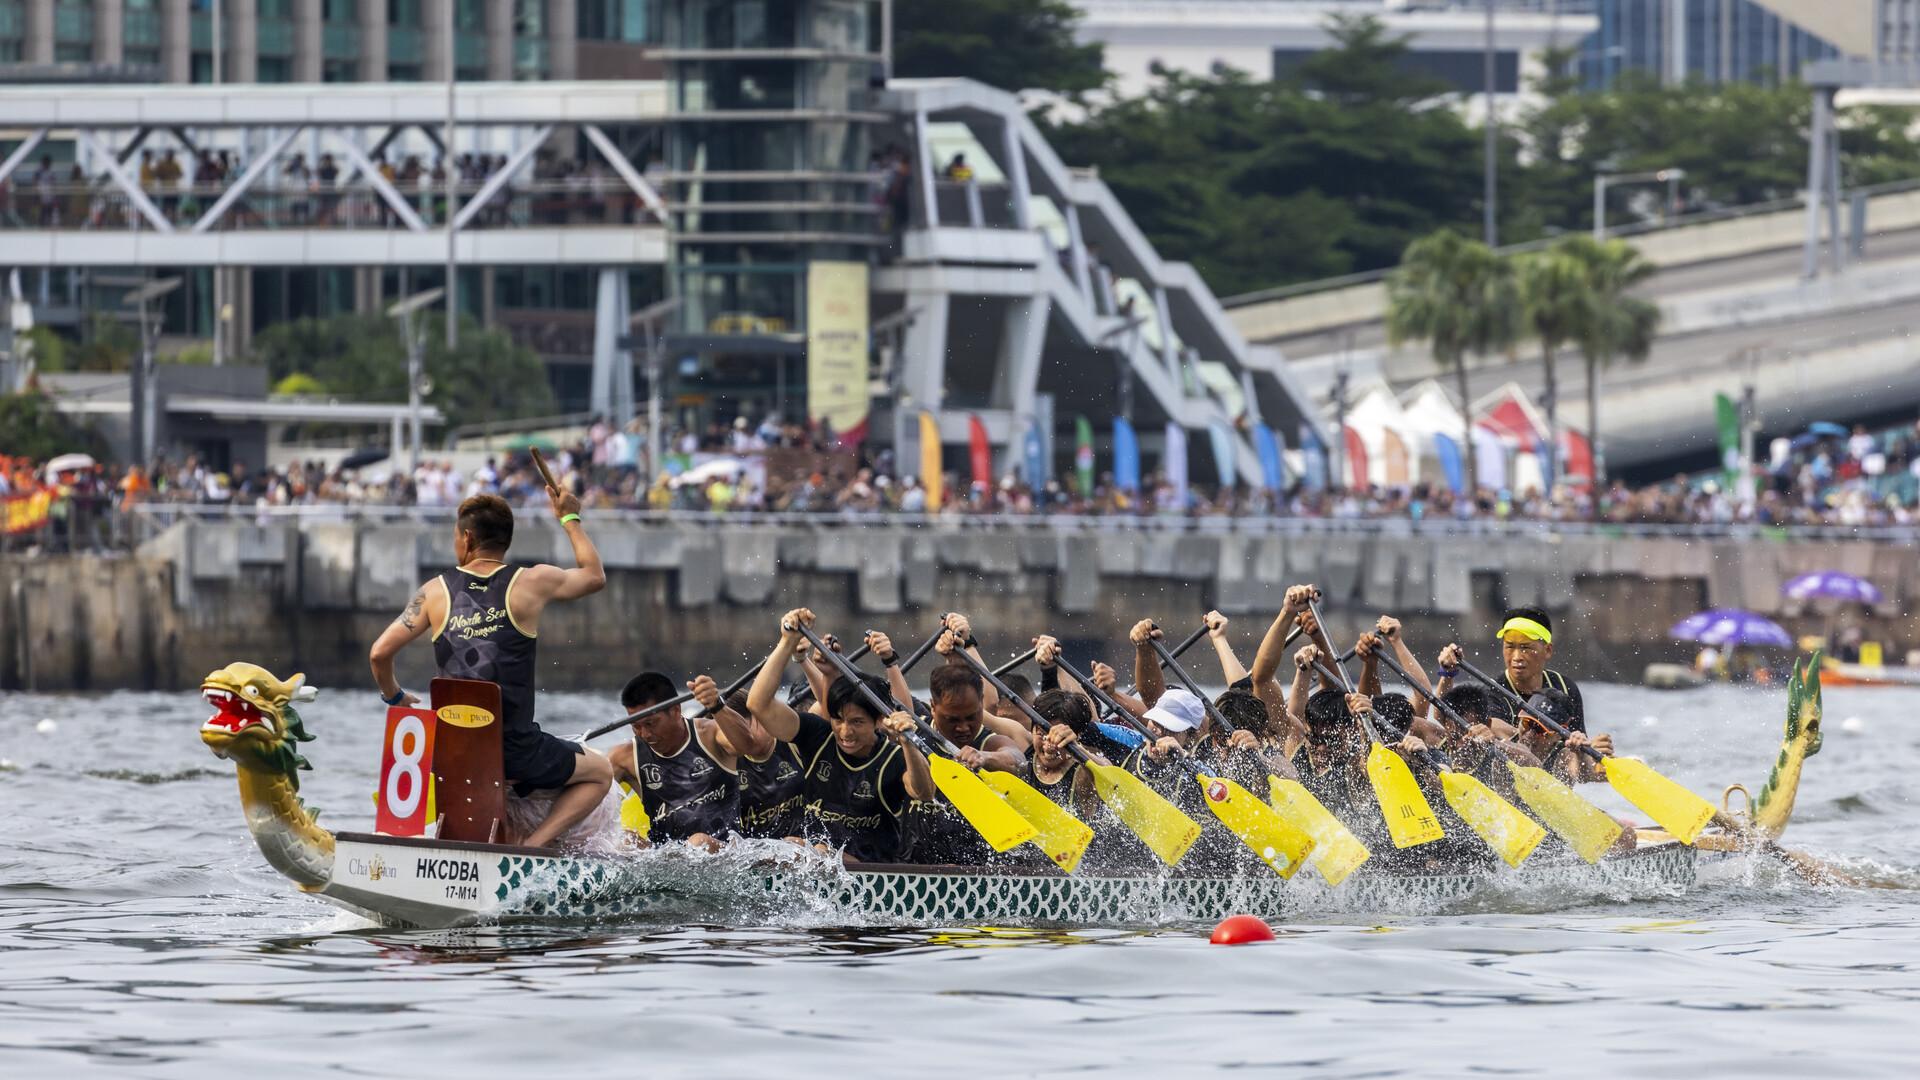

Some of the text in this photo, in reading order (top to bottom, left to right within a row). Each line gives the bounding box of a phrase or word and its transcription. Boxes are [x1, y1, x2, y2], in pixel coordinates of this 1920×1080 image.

[450, 607, 506, 631] North Sea
[387, 715, 426, 819] 8
[644, 767, 661, 783] 16
[819, 763, 831, 778] 16
[744, 794, 803, 830] ASPIRIN
[416, 858, 480, 882] HKCDBA
[445, 885, 478, 901] 17-M14
